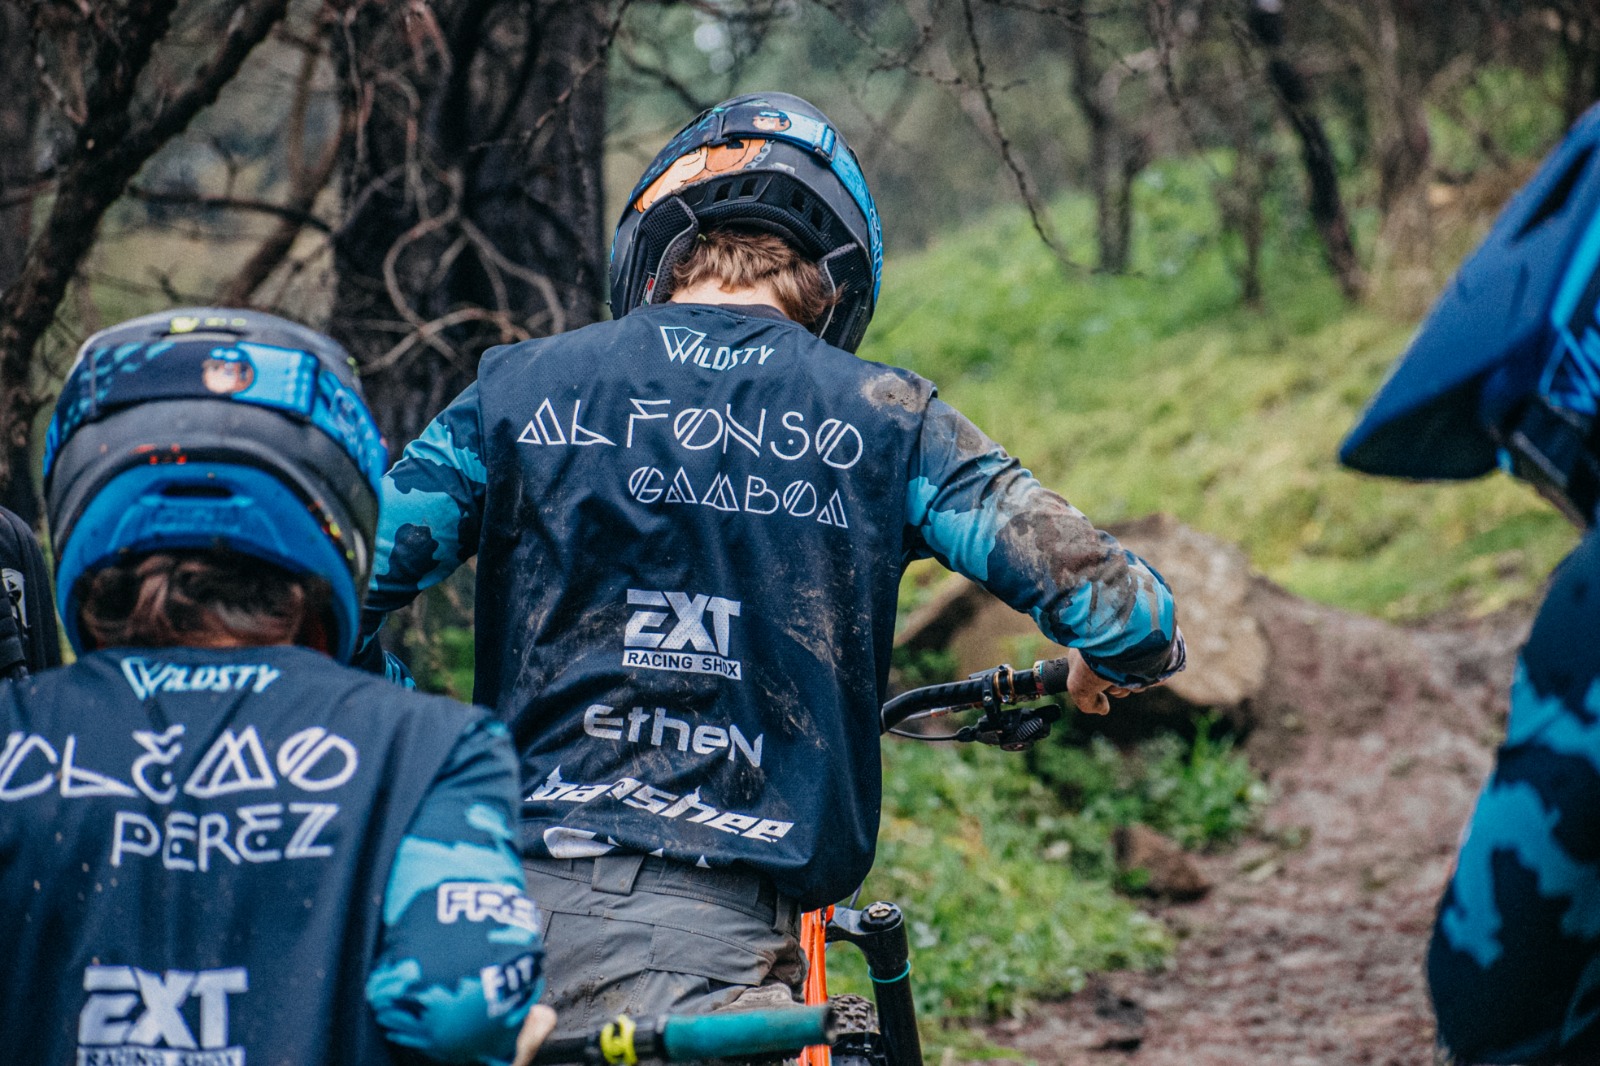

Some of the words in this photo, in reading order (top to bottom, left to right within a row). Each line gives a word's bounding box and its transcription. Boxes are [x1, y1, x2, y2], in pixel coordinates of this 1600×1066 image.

[628, 467, 848, 528] GAMBOA
[623, 588, 741, 657] EXT
[627, 652, 693, 669] RACING
[701, 657, 738, 677] SHOX
[110, 803, 340, 872] PEREZ
[78, 965, 248, 1050] EXT
